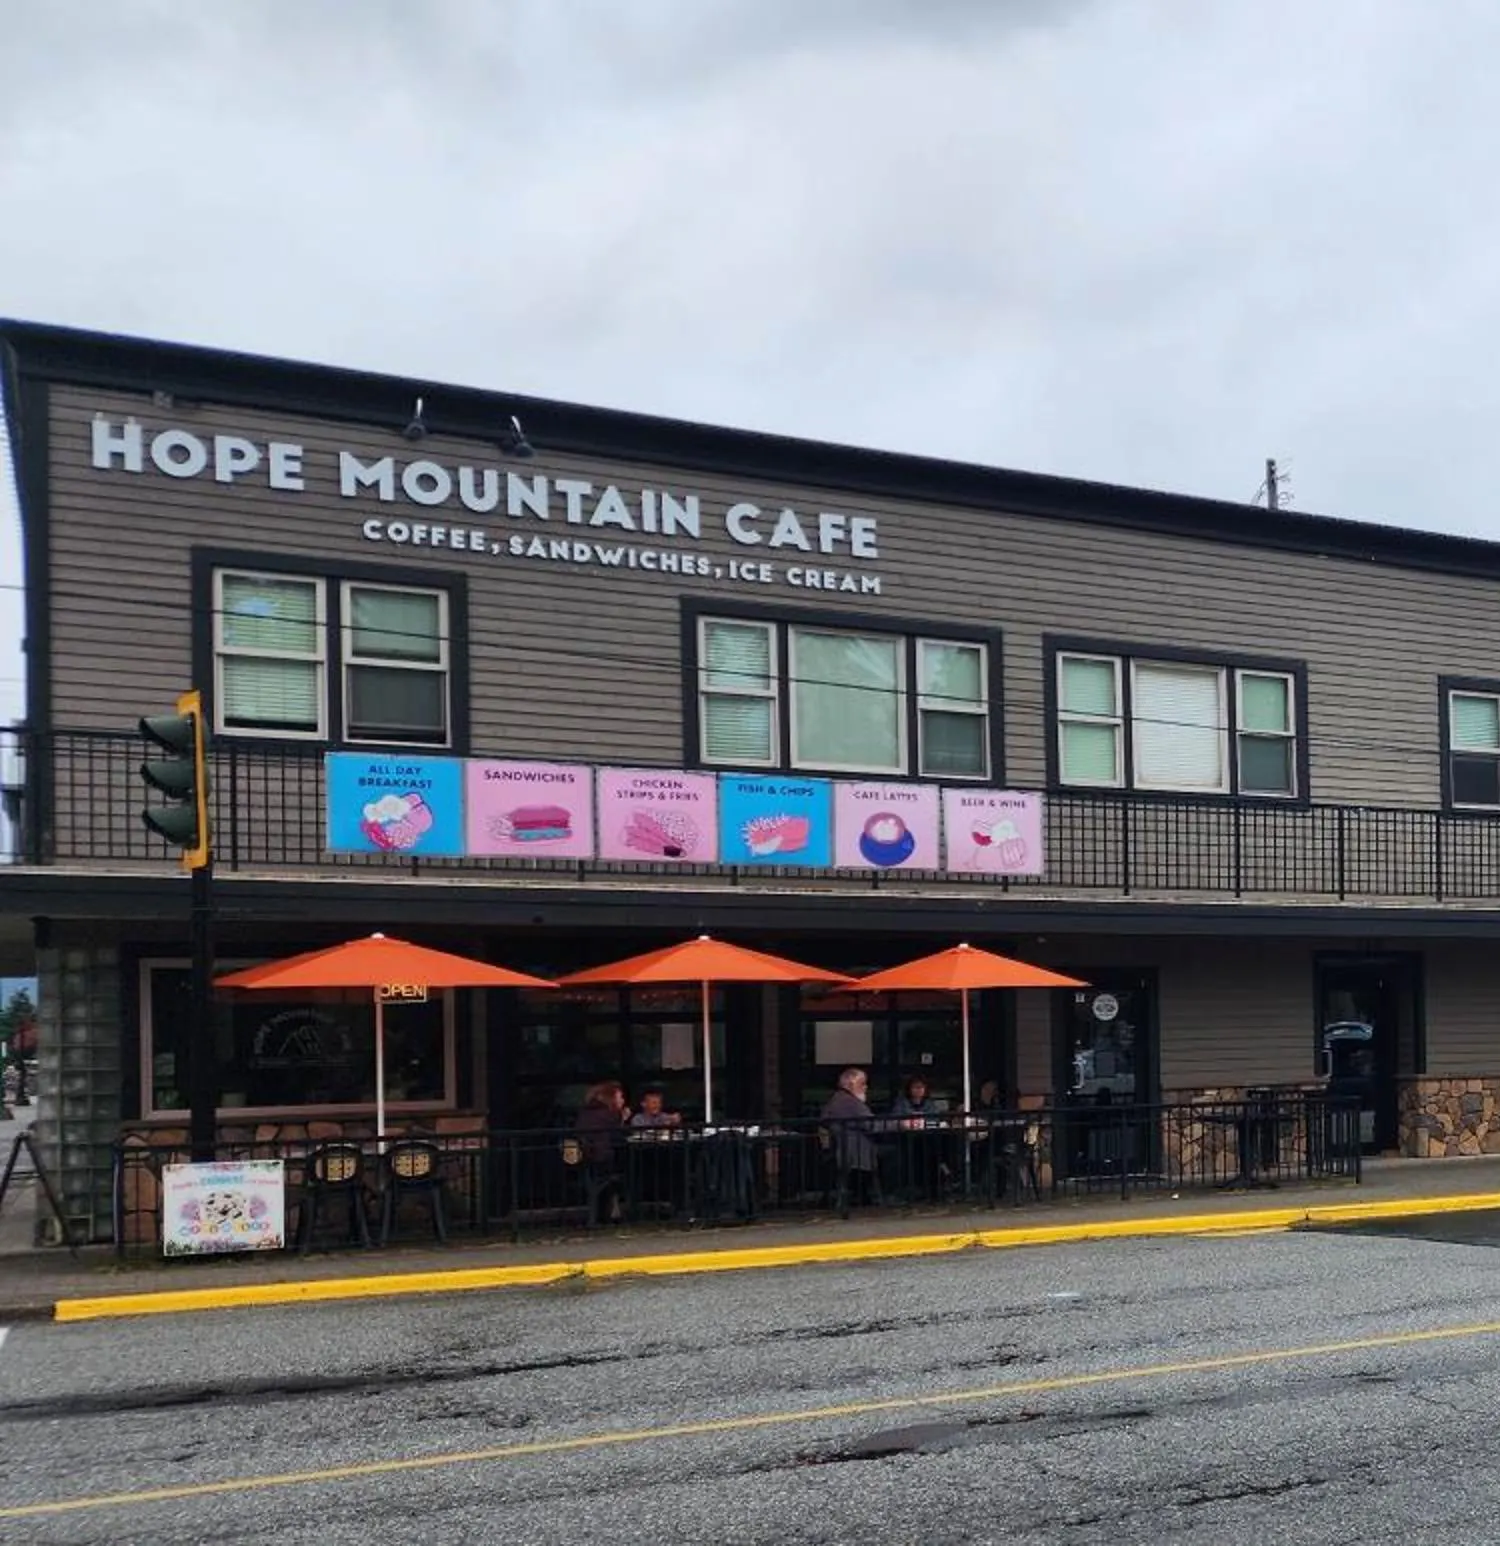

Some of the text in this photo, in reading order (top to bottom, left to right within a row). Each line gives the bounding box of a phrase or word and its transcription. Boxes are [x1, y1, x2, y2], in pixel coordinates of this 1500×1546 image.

[92, 413, 879, 559] HOPE MOUNTAIN CAFE
[362, 519, 882, 595] COFFEE, SANDWICHES, ICE CREAM
[368, 765, 422, 776] ALL DAY
[484, 769, 576, 784] SANDWICHES
[357, 777, 433, 790] BREAKFAST
[632, 779, 684, 790] CHICKEN
[658, 791, 666, 801] &
[737, 783, 816, 798] FISH & CHIPS
[853, 791, 880, 800] CAFE
[960, 797, 1027, 810] BEER & WINE
[380, 983, 424, 998] OPEN
